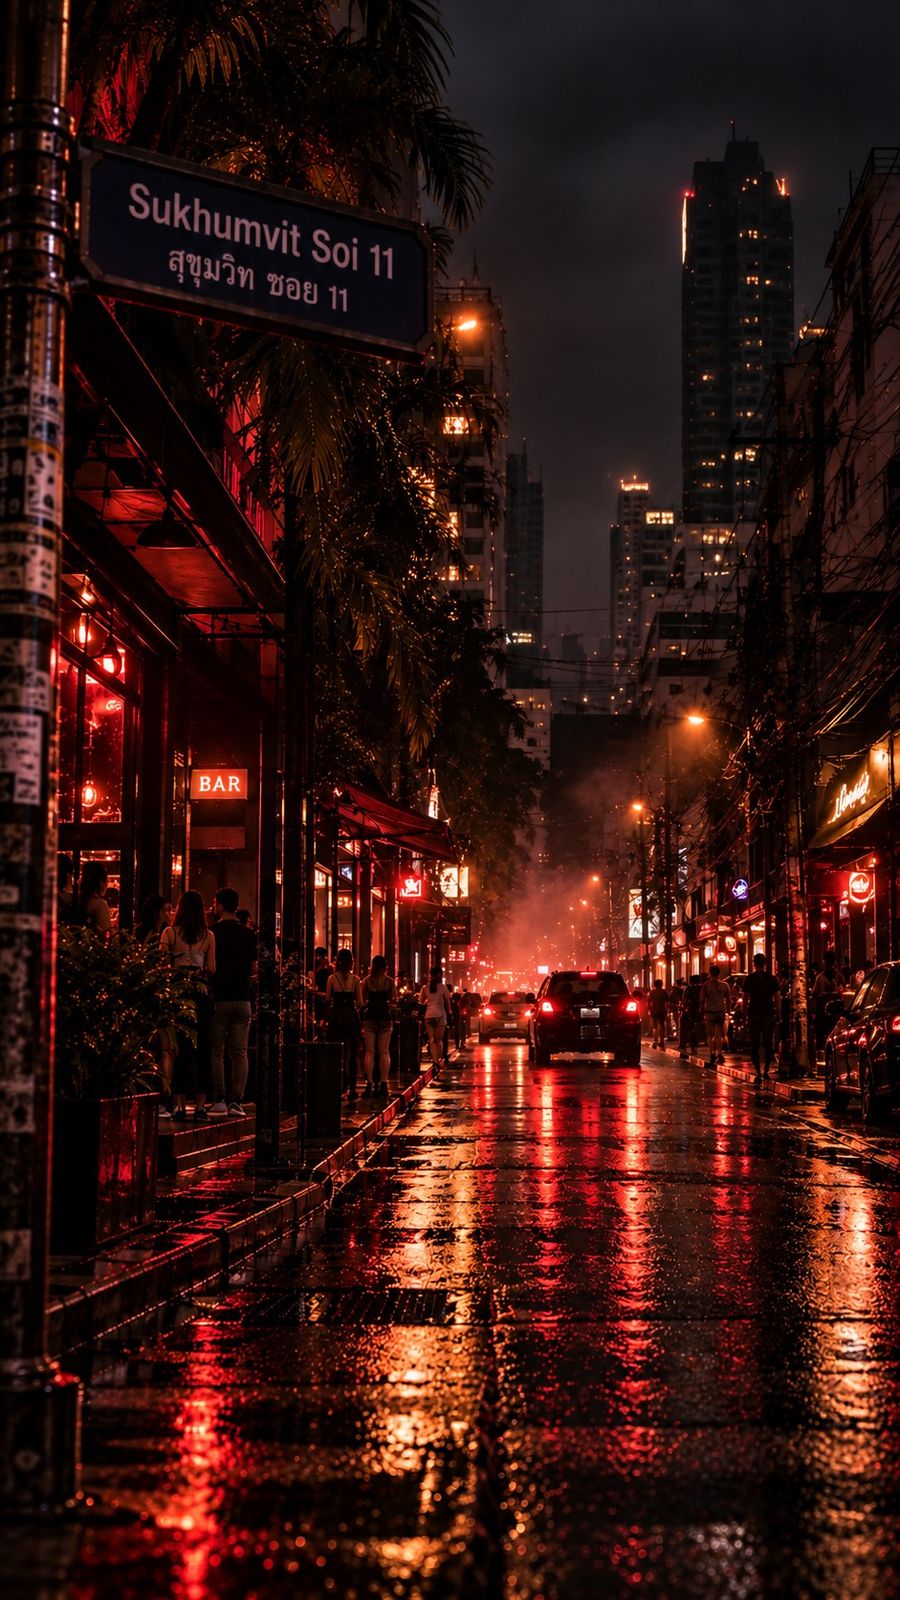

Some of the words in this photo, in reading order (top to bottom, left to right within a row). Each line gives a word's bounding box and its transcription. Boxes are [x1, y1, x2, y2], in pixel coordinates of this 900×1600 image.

[128, 182, 301, 258] Sukhumvit
[311, 229, 359, 271] Soi
[369, 244, 394, 279] 11
[168, 247, 256, 290] สุขุมวิท
[267, 271, 318, 305] ซอย
[328, 285, 348, 312] 11
[199, 775, 241, 792] BAR
